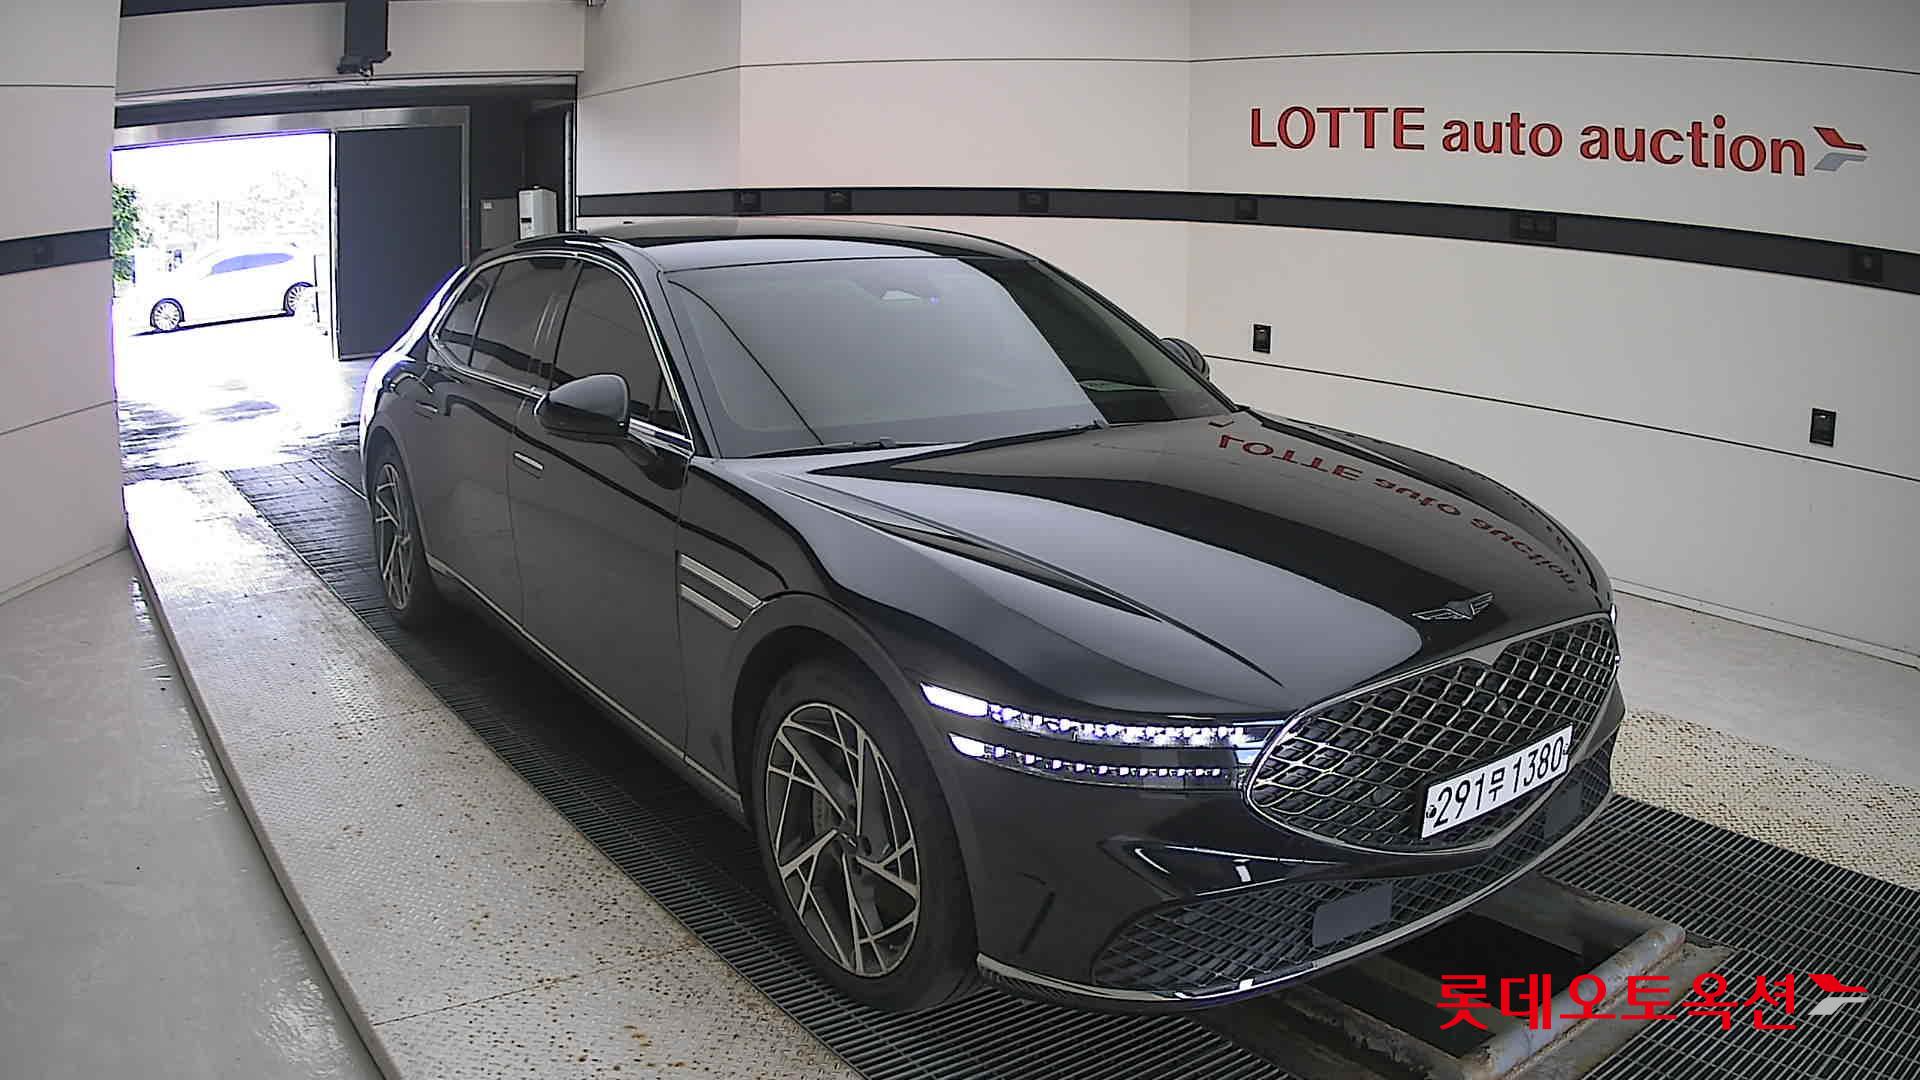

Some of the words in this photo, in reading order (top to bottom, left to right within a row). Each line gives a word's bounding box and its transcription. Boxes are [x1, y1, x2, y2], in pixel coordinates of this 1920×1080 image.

[1251, 107, 1425, 151] LOTTE
[1442, 112, 1564, 157] auto
[1581, 115, 1806, 176] auction
[1434, 768, 1505, 828] 291무
[1513, 736, 1564, 793] 1380
